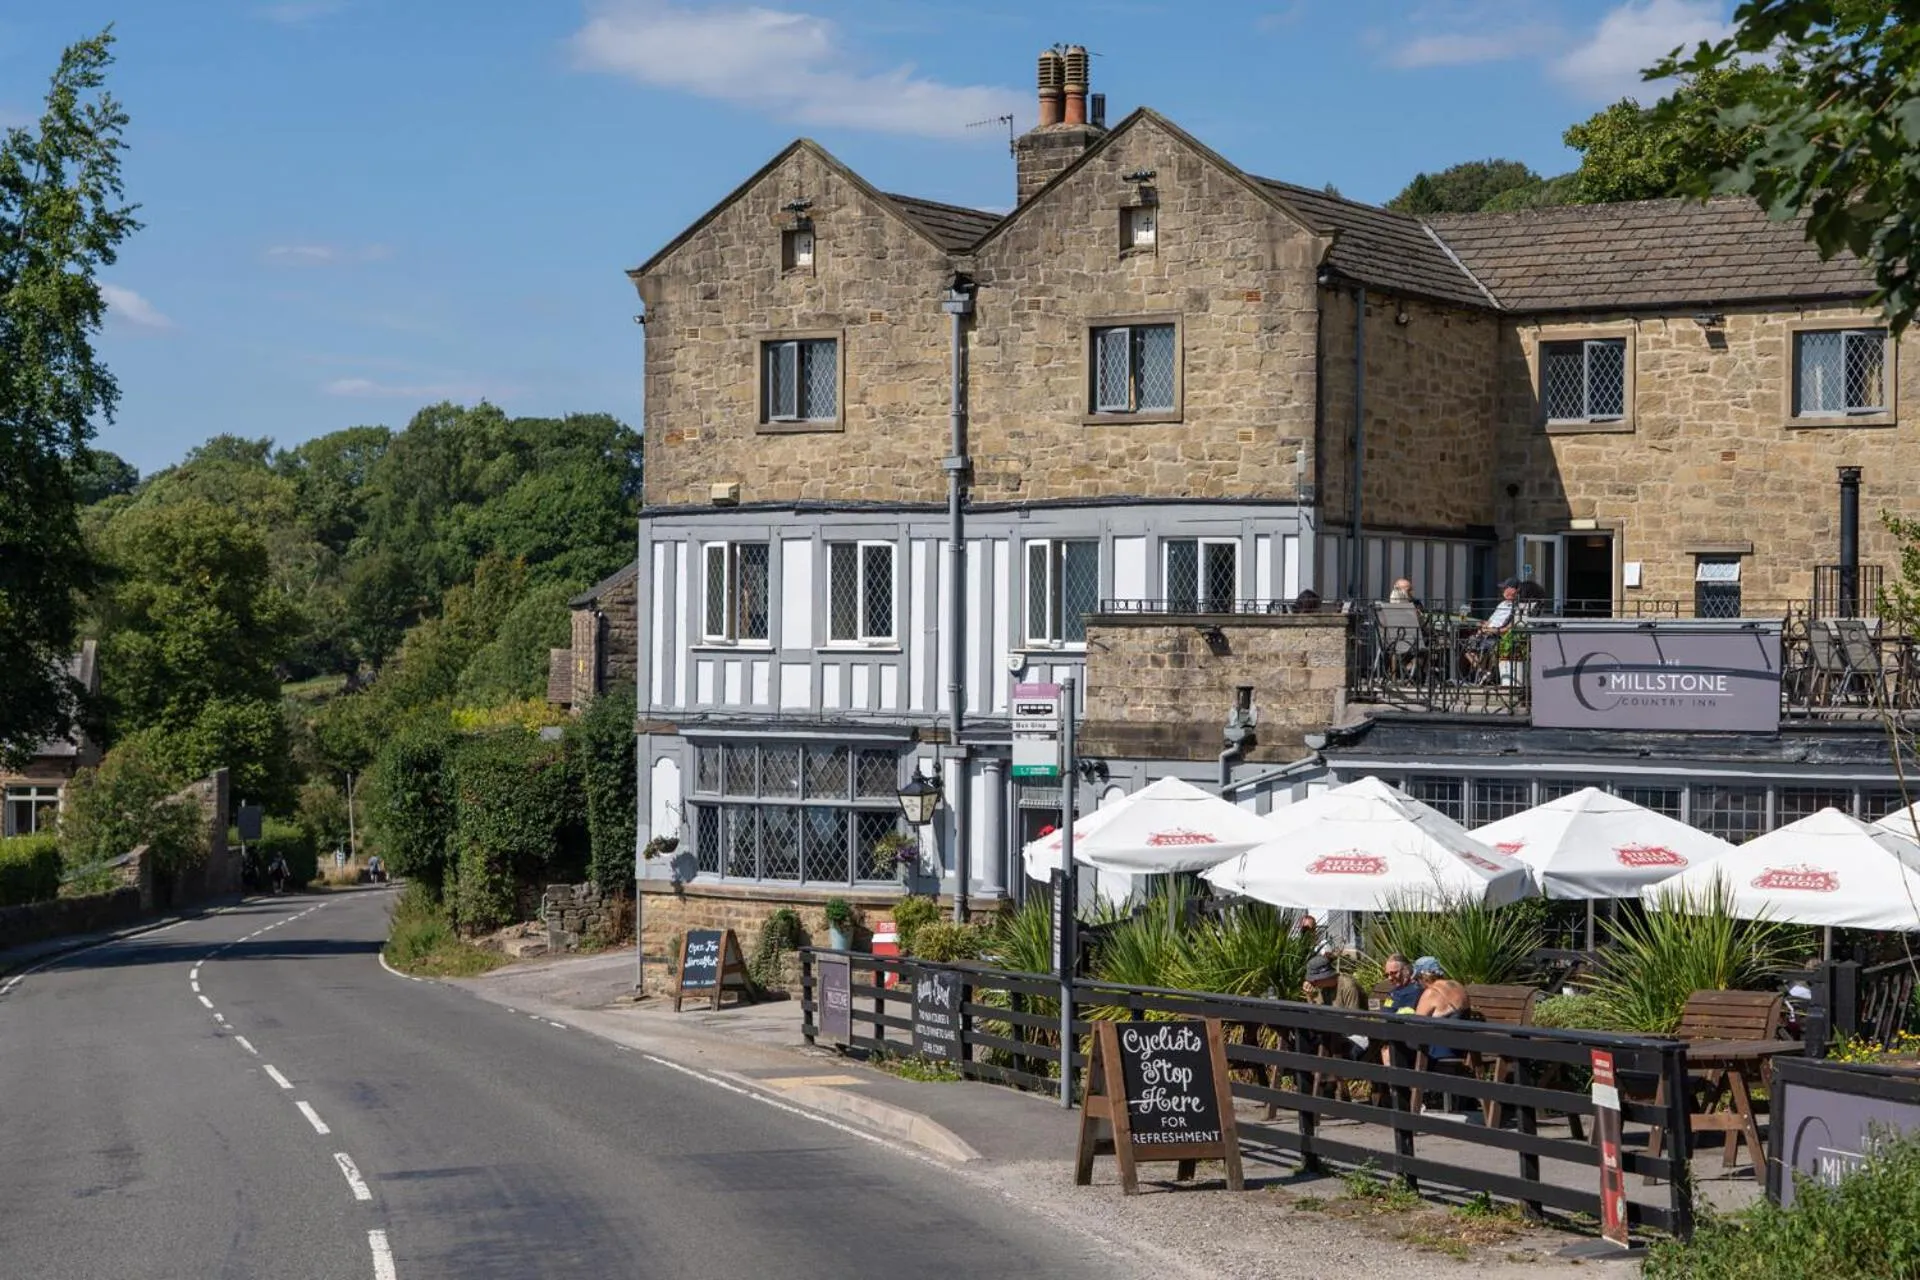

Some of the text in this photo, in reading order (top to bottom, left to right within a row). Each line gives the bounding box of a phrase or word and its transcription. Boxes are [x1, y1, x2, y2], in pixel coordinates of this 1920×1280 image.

[1610, 673, 1727, 692] MILLSTONE
[1622, 697, 1717, 707] COUNTRY INN
[1123, 1026, 1202, 1060] Cyclists
[1141, 1059, 1192, 1092] Stop
[1129, 1086, 1205, 1113] Here
[1161, 1116, 1187, 1127] FOR
